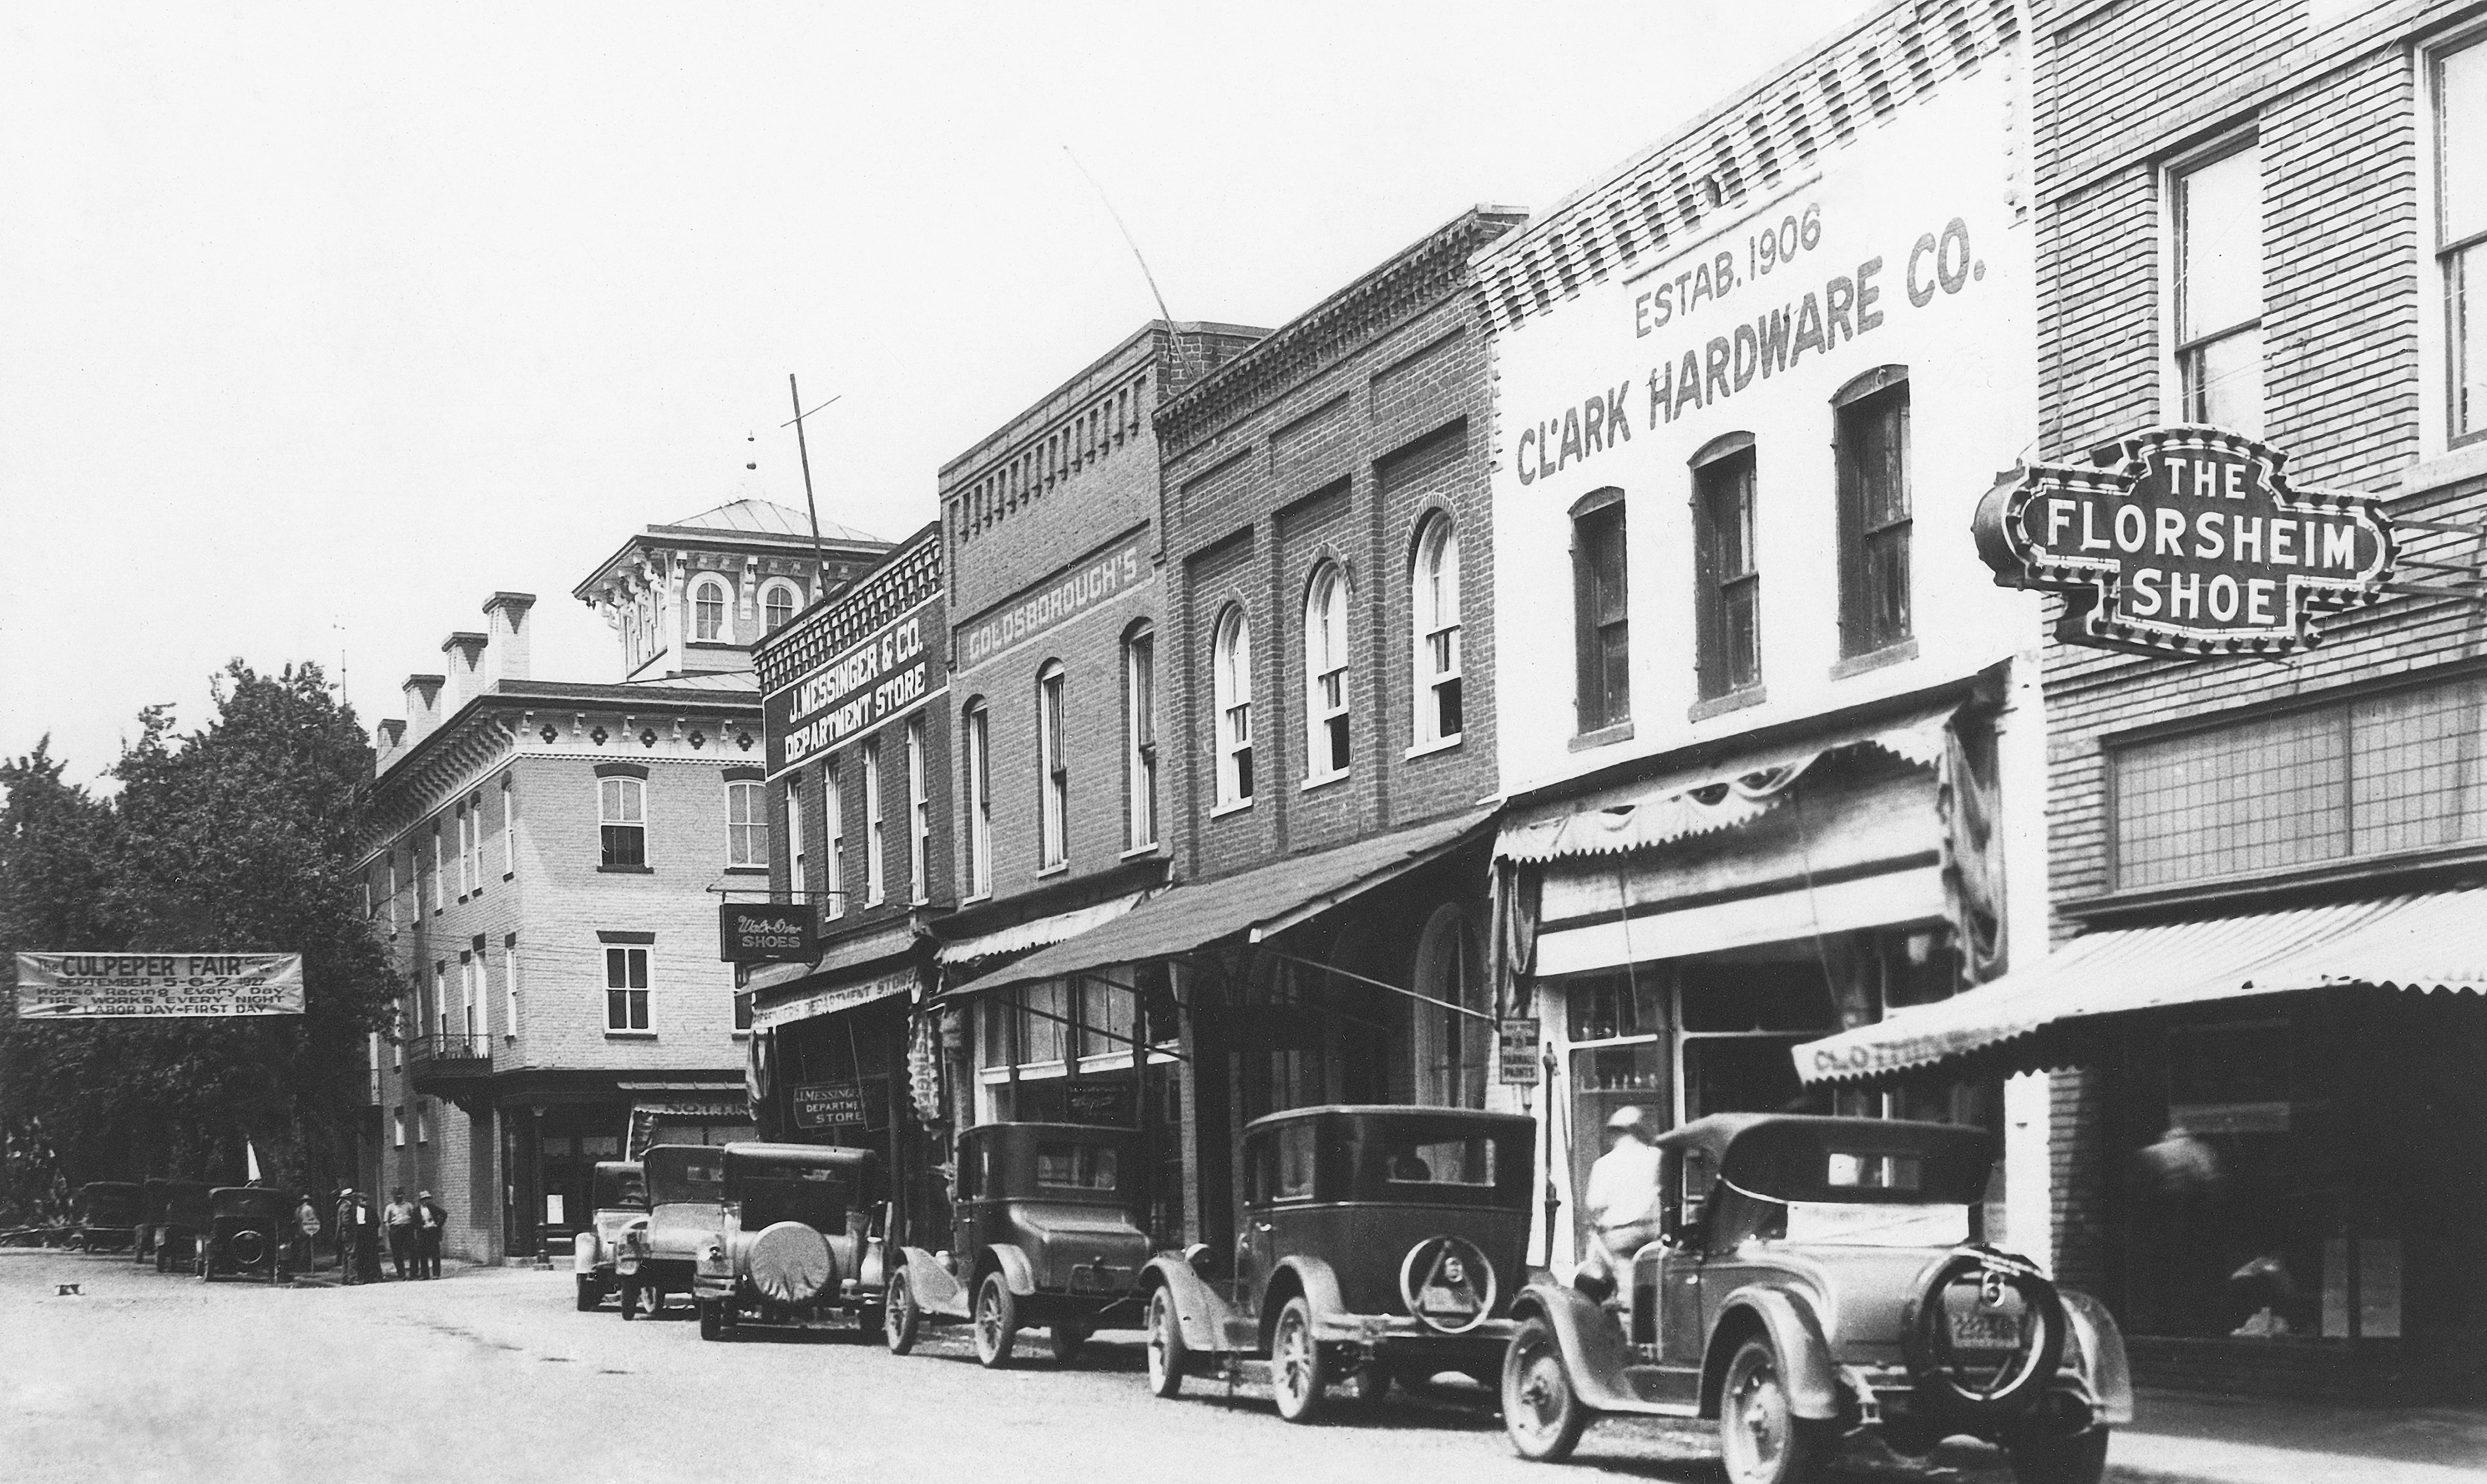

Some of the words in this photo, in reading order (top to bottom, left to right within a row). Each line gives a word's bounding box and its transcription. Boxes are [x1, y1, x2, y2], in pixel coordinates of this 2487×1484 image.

[1636, 250, 1741, 339] ESTAB.
[1750, 202, 1822, 280] 1906
[1518, 380, 1631, 485] CLARK
[1647, 256, 1884, 430] HARDWARE
[1907, 216, 1985, 308] CO.
[2164, 458, 2247, 500] THE
[2047, 499, 2355, 570] FLORSHEIM
[969, 546, 1137, 661] GOLDSBOROUGH'S
[2132, 568, 2276, 624] SHOE
[882, 632, 893, 672] &
[896, 618, 923, 663] CO.
[785, 692, 872, 763] DEPARTMENT
[876, 661, 925, 717] STORE
[742, 935, 801, 948] SHOES
[57, 977, 151, 987] SEPTEMBER
[62, 956, 175, 977] CULPEPER
[189, 956, 241, 976] FAIR
[105, 988, 168, 997] Racing
[184, 987, 240, 997] Every
[235, 995, 285, 1004] NIGHT
[235, 1004, 268, 1014] DAY
[816, 1111, 863, 1123] STORE
